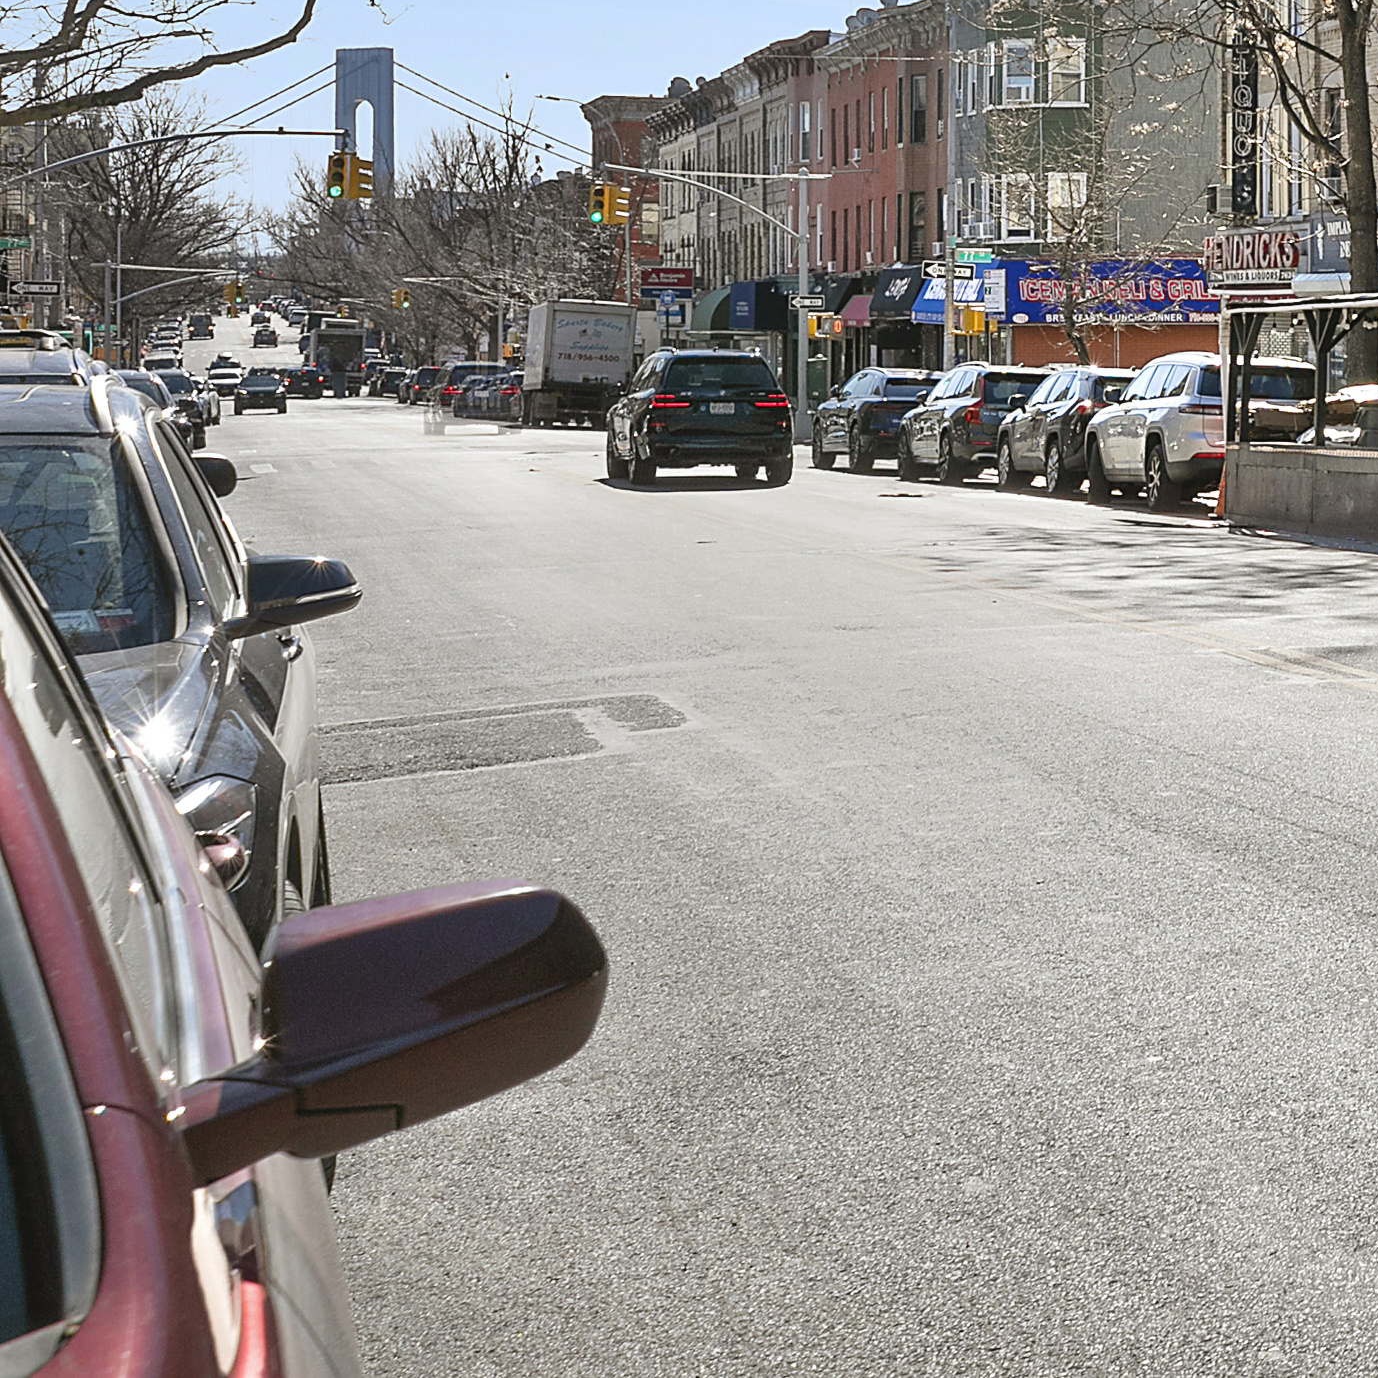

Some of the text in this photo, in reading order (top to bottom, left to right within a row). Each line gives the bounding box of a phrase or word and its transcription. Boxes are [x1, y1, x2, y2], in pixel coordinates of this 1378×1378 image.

[1203, 232, 1294, 271] HENDRICKS
[1225, 272, 1244, 281] WINES
[1251, 271, 1278, 281] LIQUORS
[1103, 278, 1146, 302] DELI
[1150, 279, 1165, 301] &
